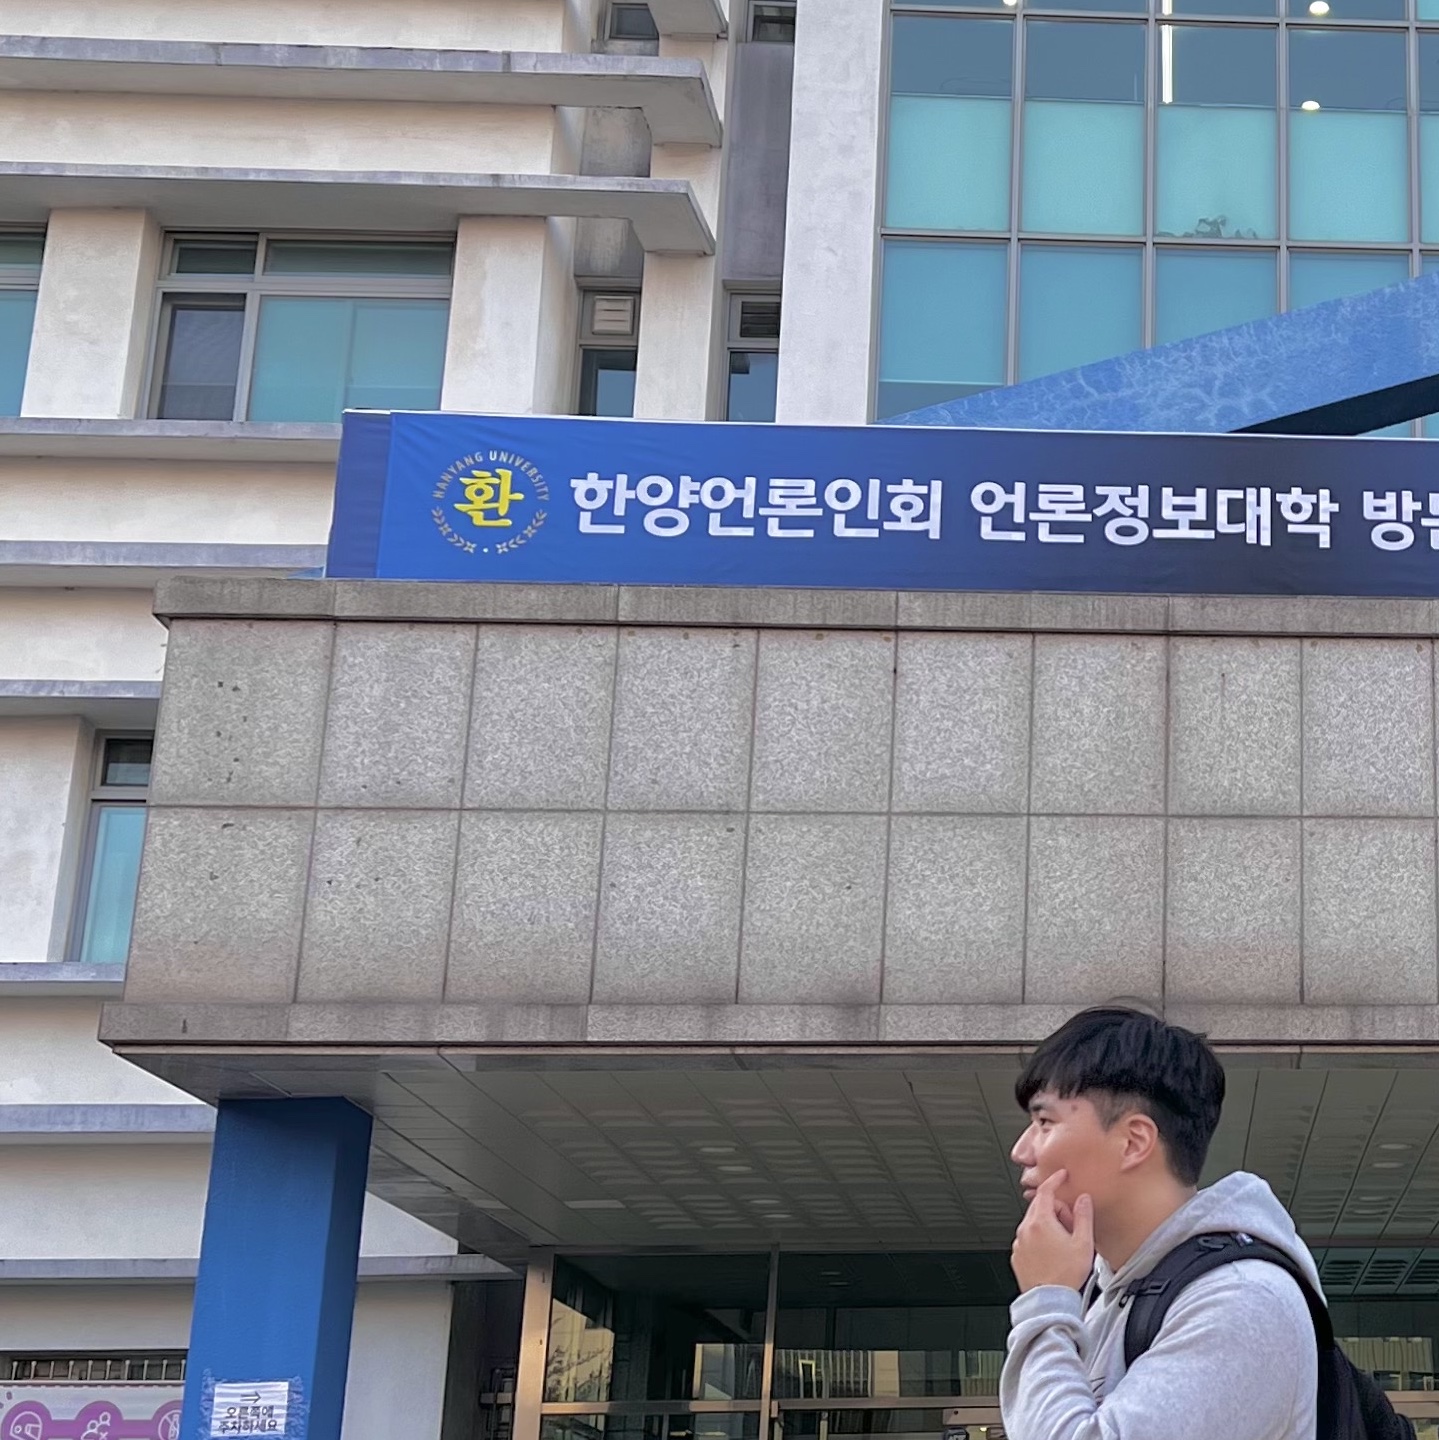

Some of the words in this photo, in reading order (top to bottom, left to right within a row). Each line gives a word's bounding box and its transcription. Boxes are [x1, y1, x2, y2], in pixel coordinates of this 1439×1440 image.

[432, 451, 484, 499] HANYANG
[489, 450, 550, 500] UNIVERSITY
[453, 468, 525, 527] 환
[569, 472, 943, 540] 한양언론인회
[969, 481, 1338, 549] 언론정보대학
[219, 1419, 278, 1434] 주차하세요
[225, 1405, 274, 1419] 오른쪽에
